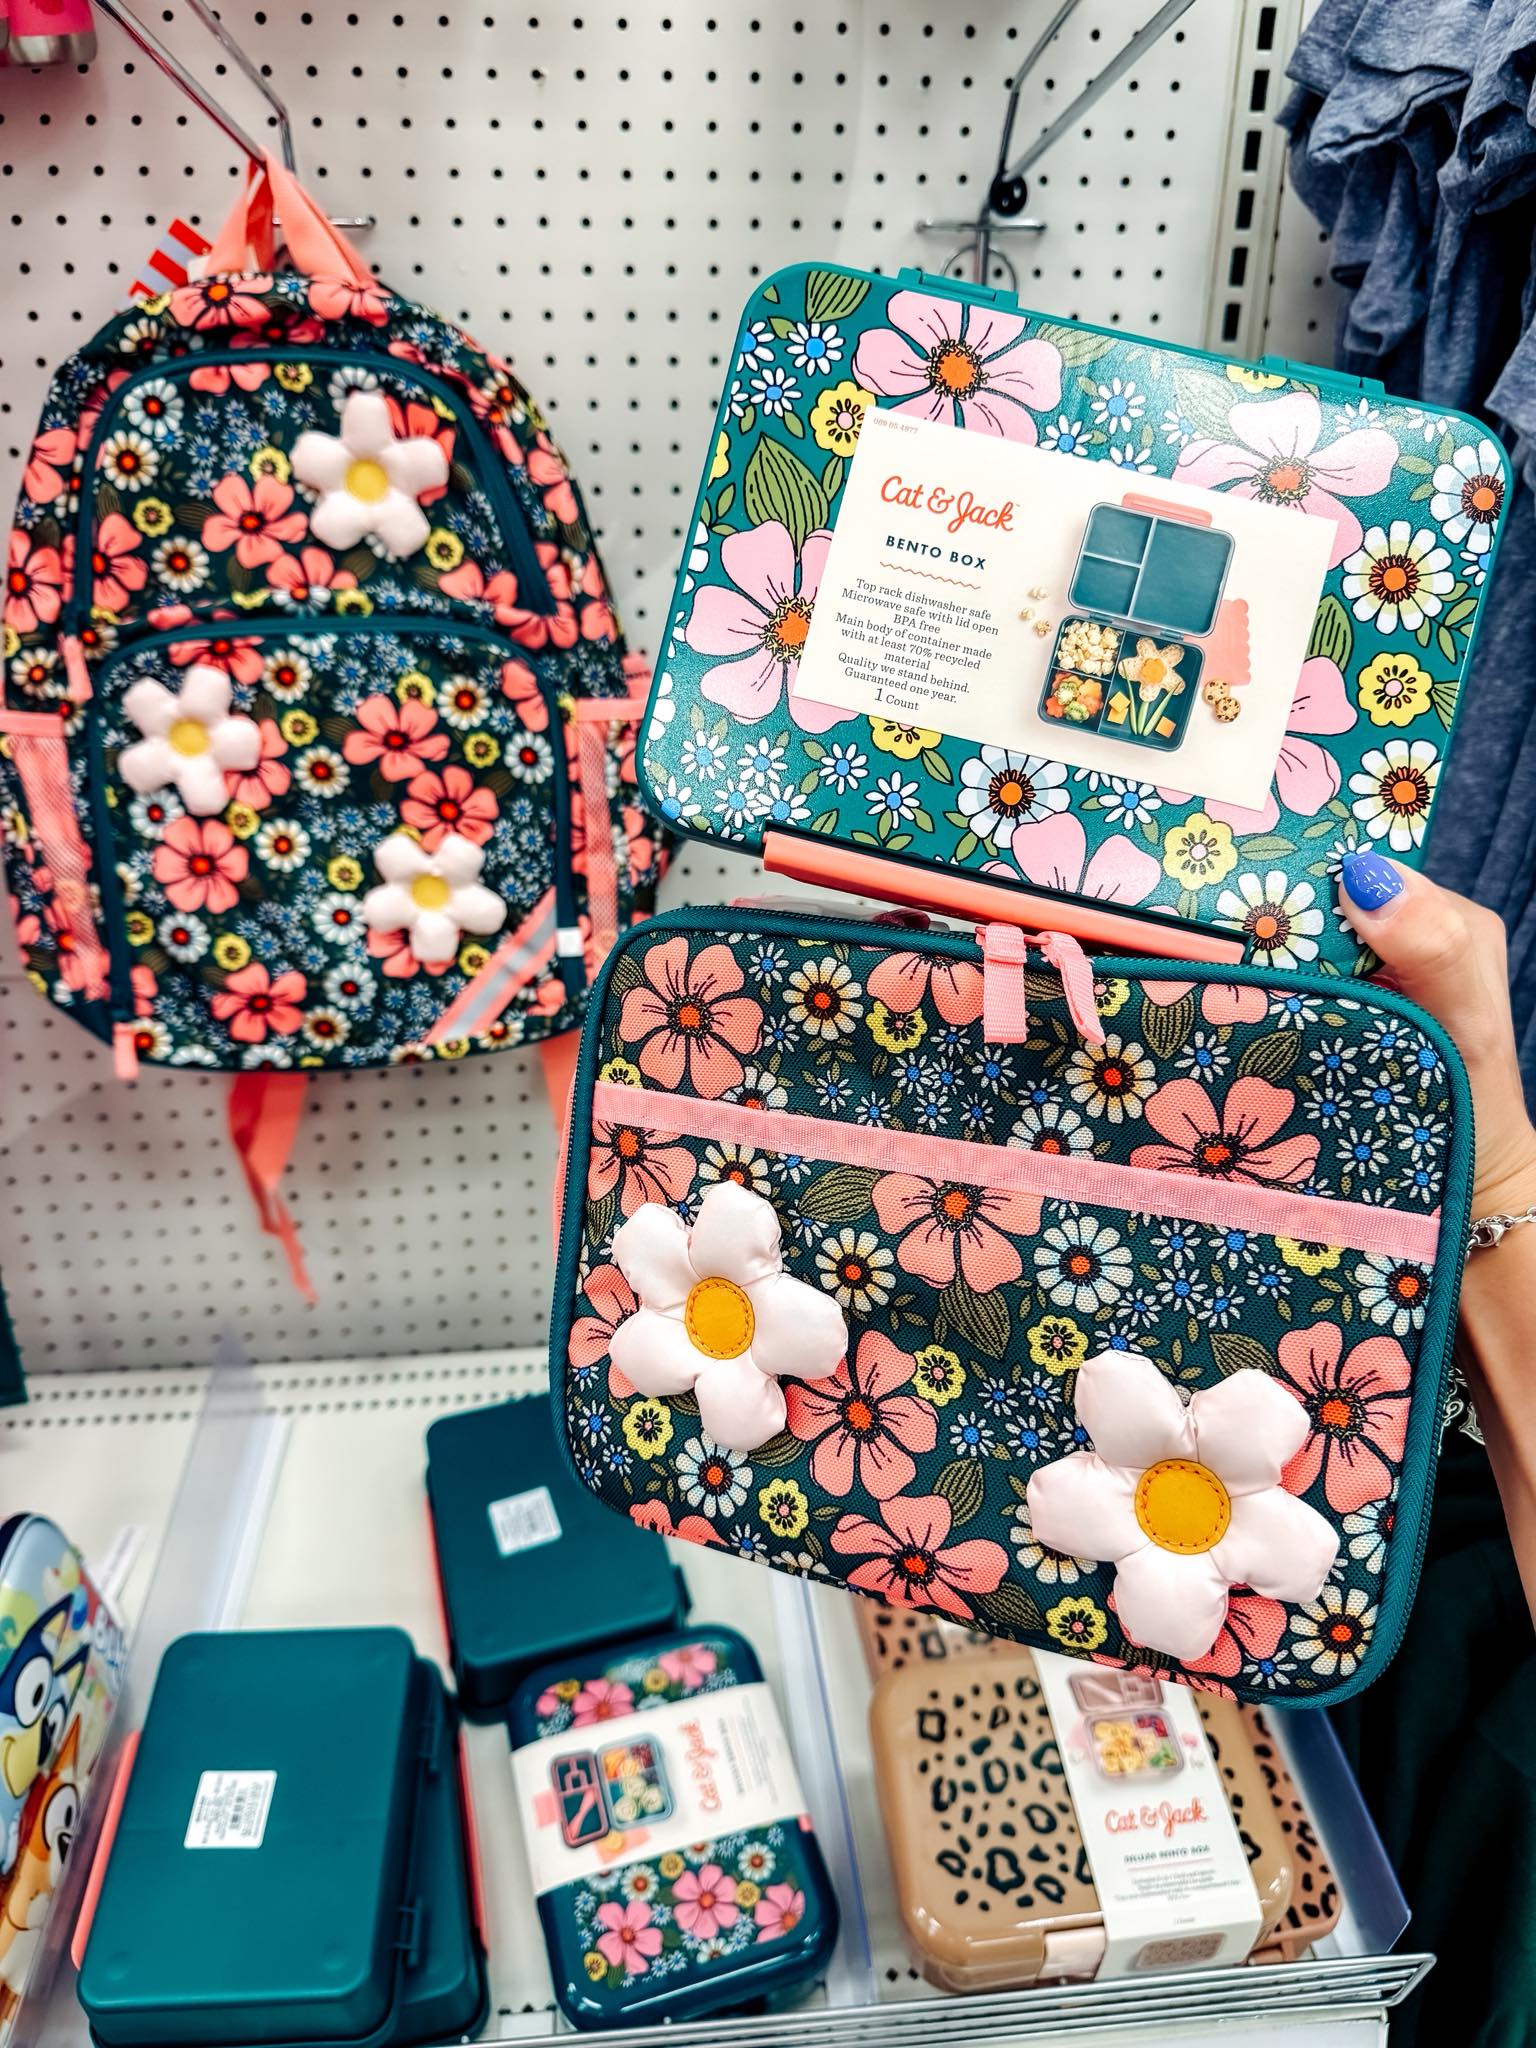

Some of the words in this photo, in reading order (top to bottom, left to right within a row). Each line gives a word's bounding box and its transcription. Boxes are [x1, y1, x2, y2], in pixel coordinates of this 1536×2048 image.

[881, 476, 924, 508] Cat
[927, 487, 954, 514] &
[948, 492, 1014, 533] Jack
[886, 536, 942, 558] BENTO
[950, 552, 986, 570] BOX
[842, 588, 902, 612] Microwave
[904, 605, 926, 617] safe
[929, 610, 953, 624] with
[955, 616, 970, 628] lid
[972, 623, 999, 636] open
[857, 578, 876, 592] Top
[879, 586, 902, 599] rack
[905, 590, 967, 614] dishwasher
[969, 609, 992, 620] safe
[836, 612, 864, 628] Main
[867, 620, 893, 636] body
[895, 626, 907, 638] of
[908, 633, 961, 652] container
[963, 645, 992, 660] made
[894, 614, 916, 628] BPA
[919, 620, 941, 634] free
[842, 628, 865, 642] with
[868, 634, 879, 644] at
[881, 636, 907, 652] least
[910, 644, 932, 658] 70%
[934, 650, 981, 670] recycled
[884, 653, 930, 670] material
[838, 652, 878, 672] Quality
[881, 665, 896, 675] we
[897, 669, 928, 683] stand
[930, 675, 970, 694] behind.
[845, 667, 908, 690] Guaranteed
[910, 685, 929, 696] one
[931, 690, 957, 703] year.
[875, 688, 883, 702] 1
[886, 694, 919, 710] Count
[1105, 1809, 1138, 1834] Cat
[1140, 1805, 1158, 1828] &
[1158, 1796, 1208, 1838] Jack
